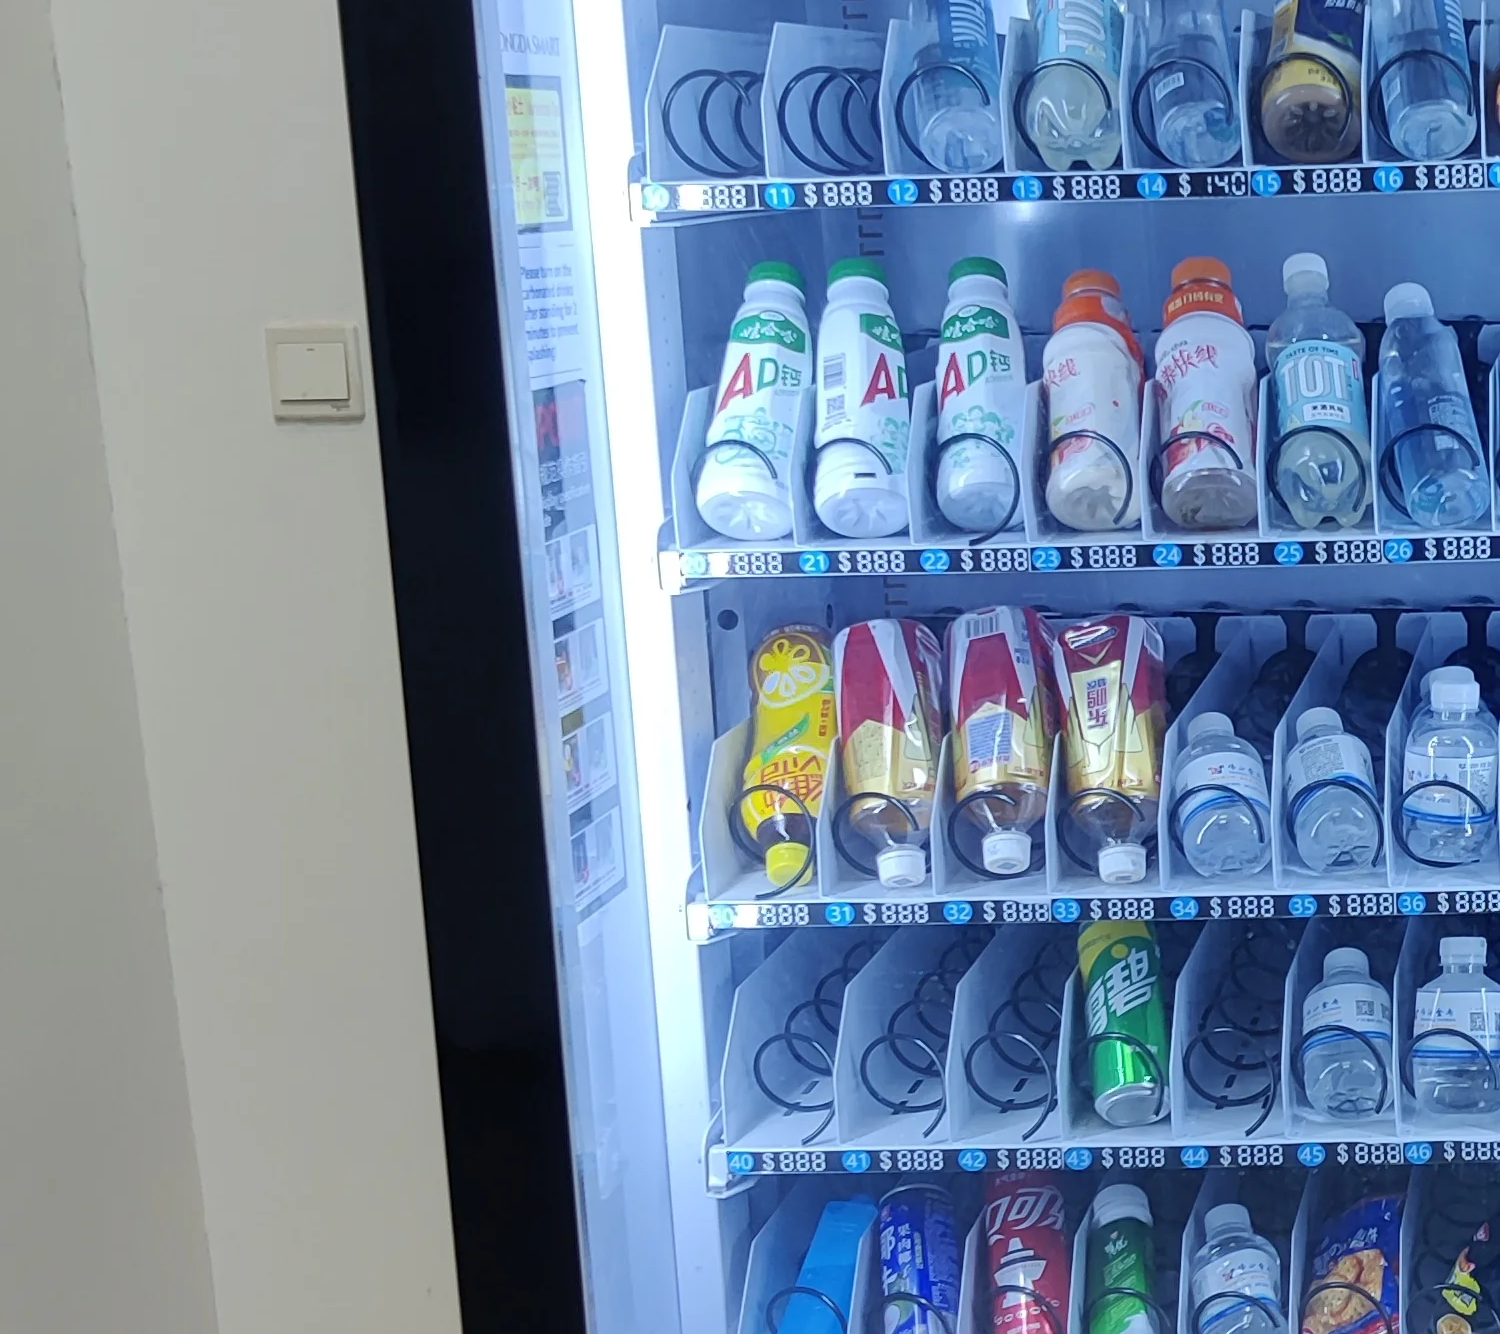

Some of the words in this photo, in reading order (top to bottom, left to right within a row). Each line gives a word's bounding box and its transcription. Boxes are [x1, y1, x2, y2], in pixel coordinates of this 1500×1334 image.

[1016, 180, 1040, 198] 13
[1142, 178, 1165, 195] 14
[1256, 175, 1278, 192] 15
[771, 187, 791, 205] 11
[1281, 354, 1347, 408] TOT
[1036, 551, 1058, 567] 23
[1157, 548, 1179, 563] 24
[1278, 545, 1299, 561] 25
[805, 555, 826, 571] 21
[1056, 902, 1077, 917] 33
[1293, 898, 1314, 913] 35
[830, 907, 850, 922] 31
[847, 1154, 867, 1169] 41
[1069, 1150, 1090, 1165] 43
[1301, 1147, 1323, 1162] 45
